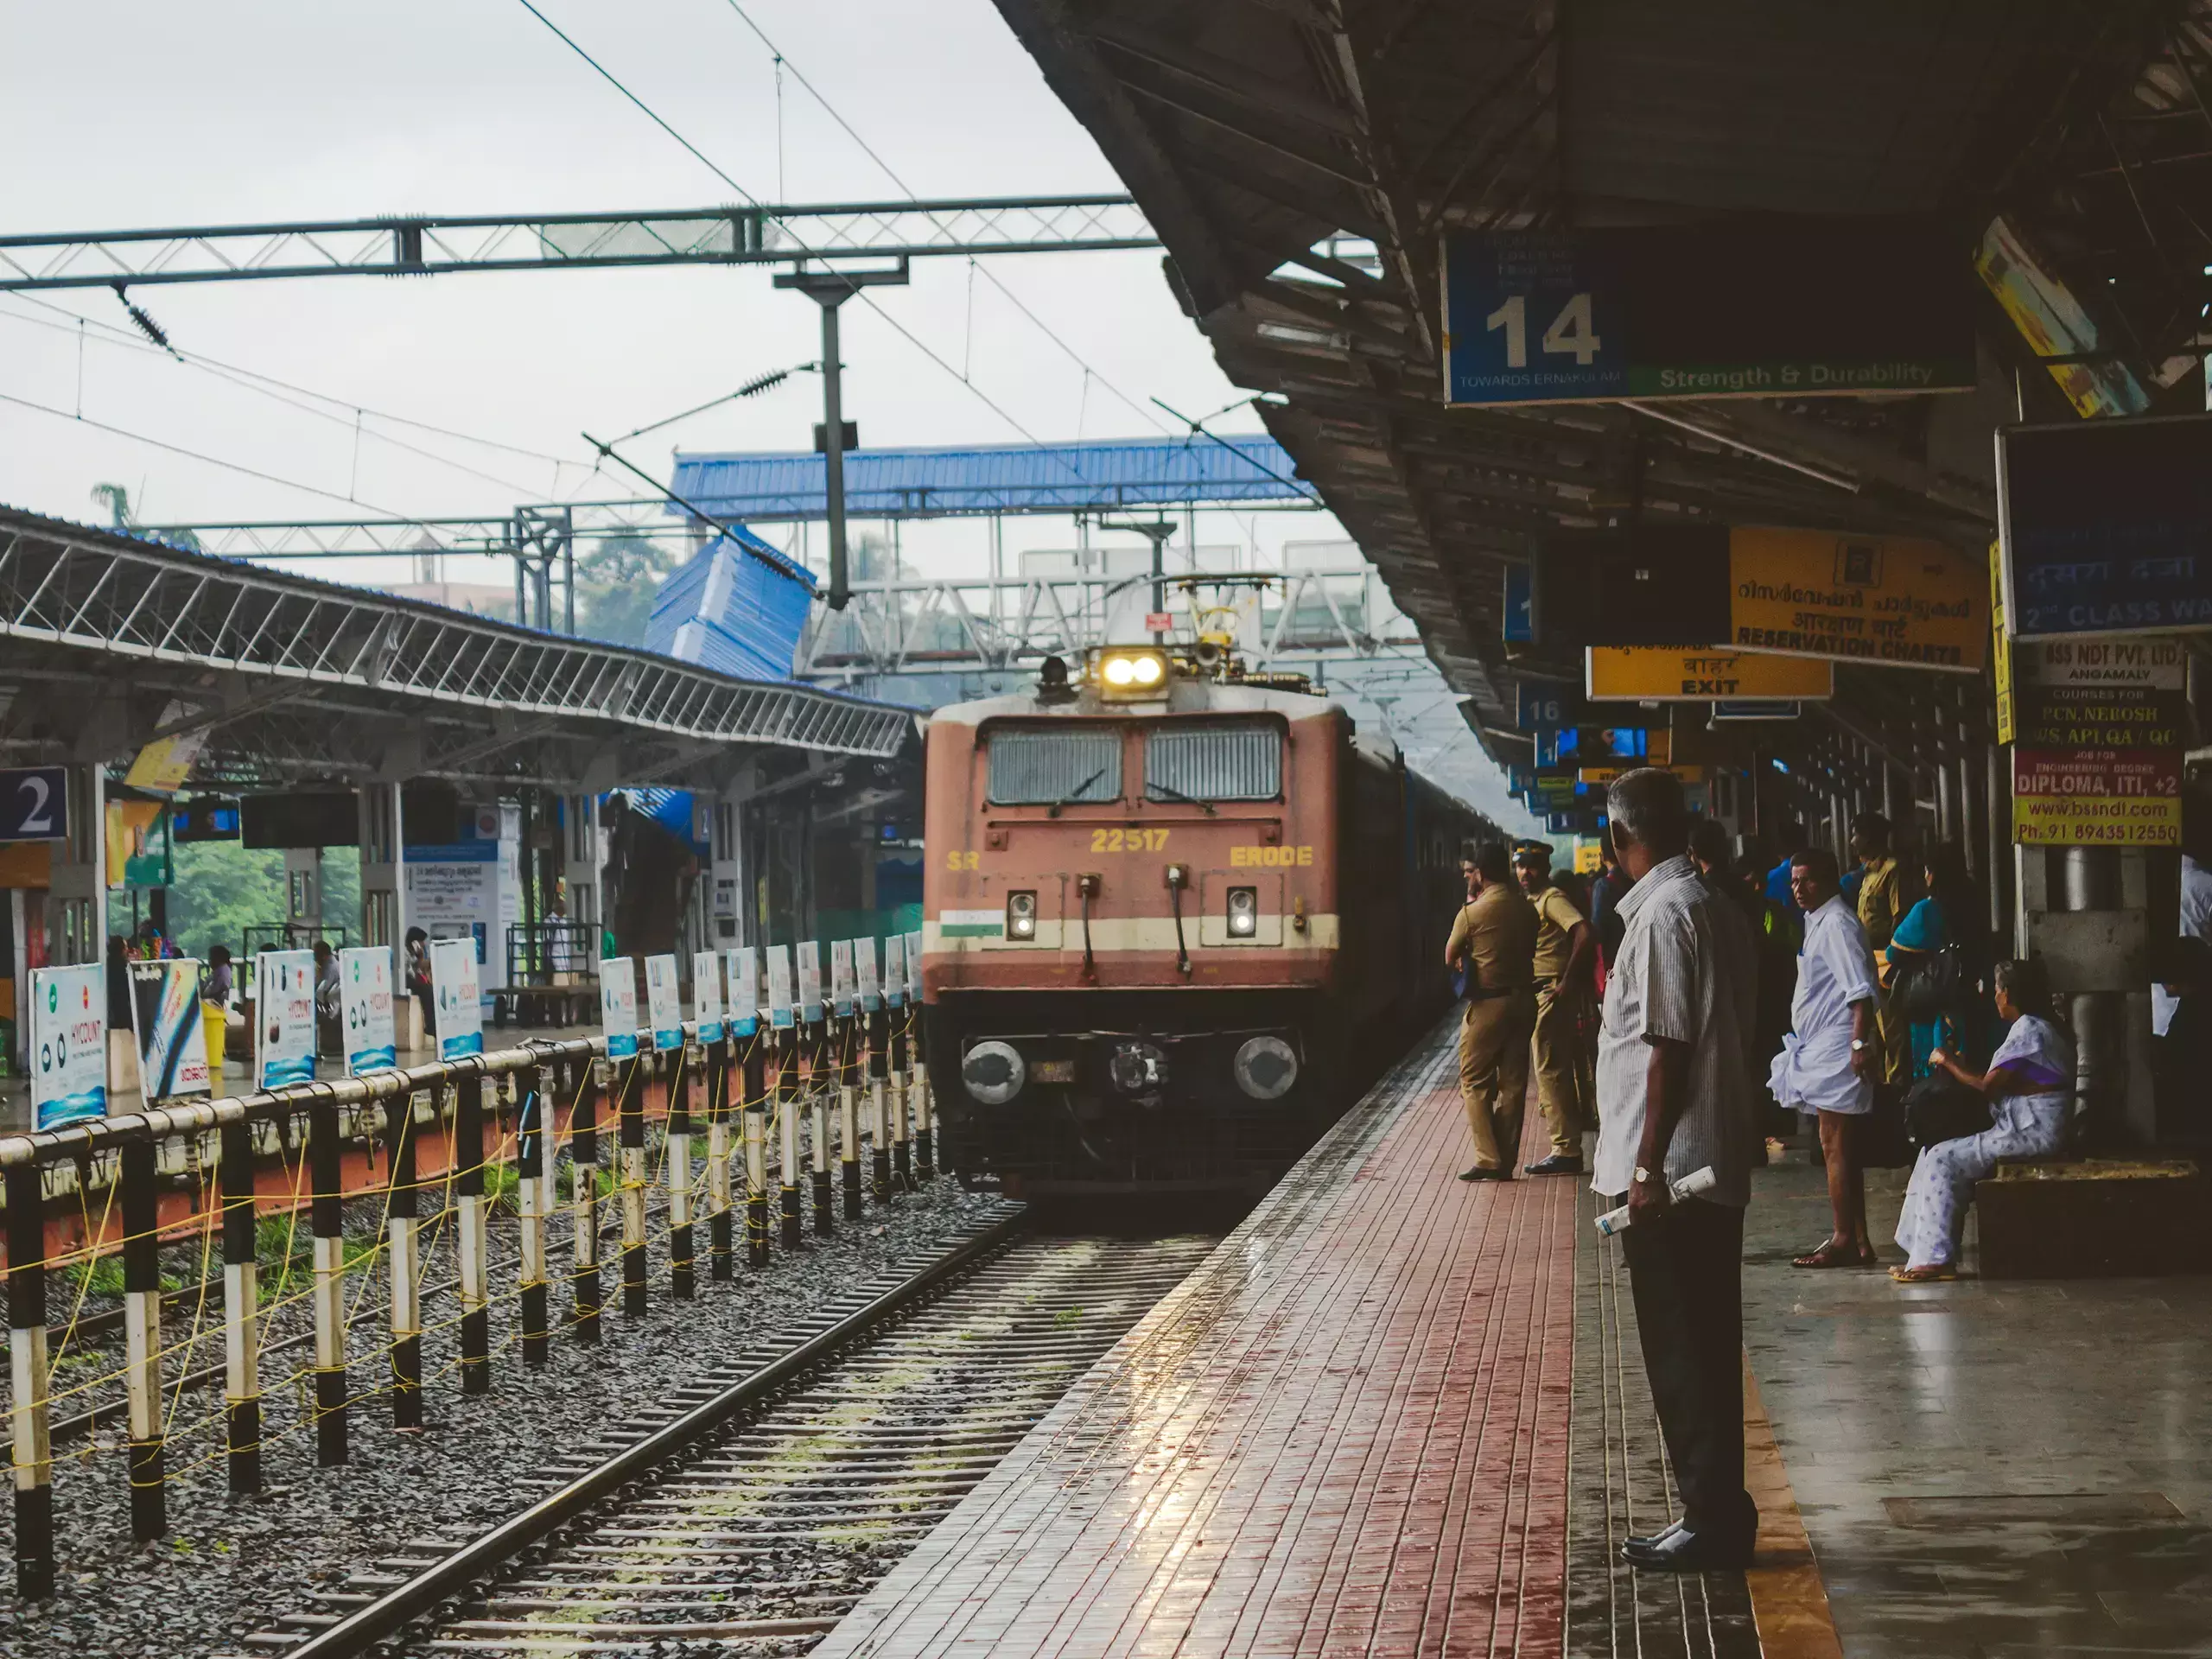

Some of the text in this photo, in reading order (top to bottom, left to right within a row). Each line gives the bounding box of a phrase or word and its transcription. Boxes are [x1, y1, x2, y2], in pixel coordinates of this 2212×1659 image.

[1486, 292, 1601, 369] 14
[1459, 372, 1530, 389] TOWARDS
[1660, 362, 1934, 390] Strength & Durability
[2068, 600, 2162, 626] CLASS
[1737, 626, 1875, 658] RESERVATION
[1881, 642, 1962, 664] CHARTS
[2077, 644, 2110, 665] NDT
[2069, 669, 2151, 681] ANGAMALY
[1681, 679, 1740, 696] EXIT
[1529, 700, 1560, 721] 16
[2035, 762, 2107, 774] ENGINEERING
[2018, 774, 2177, 798] DIPLOMA, ITI, +2
[17, 775, 53, 833] 2
[1090, 829, 1170, 853] 22517
[2048, 823, 2067, 840] 91
[2075, 823, 2177, 842] 8943512550
[947, 850, 980, 871] SR
[1230, 845, 1313, 867] ERODE
